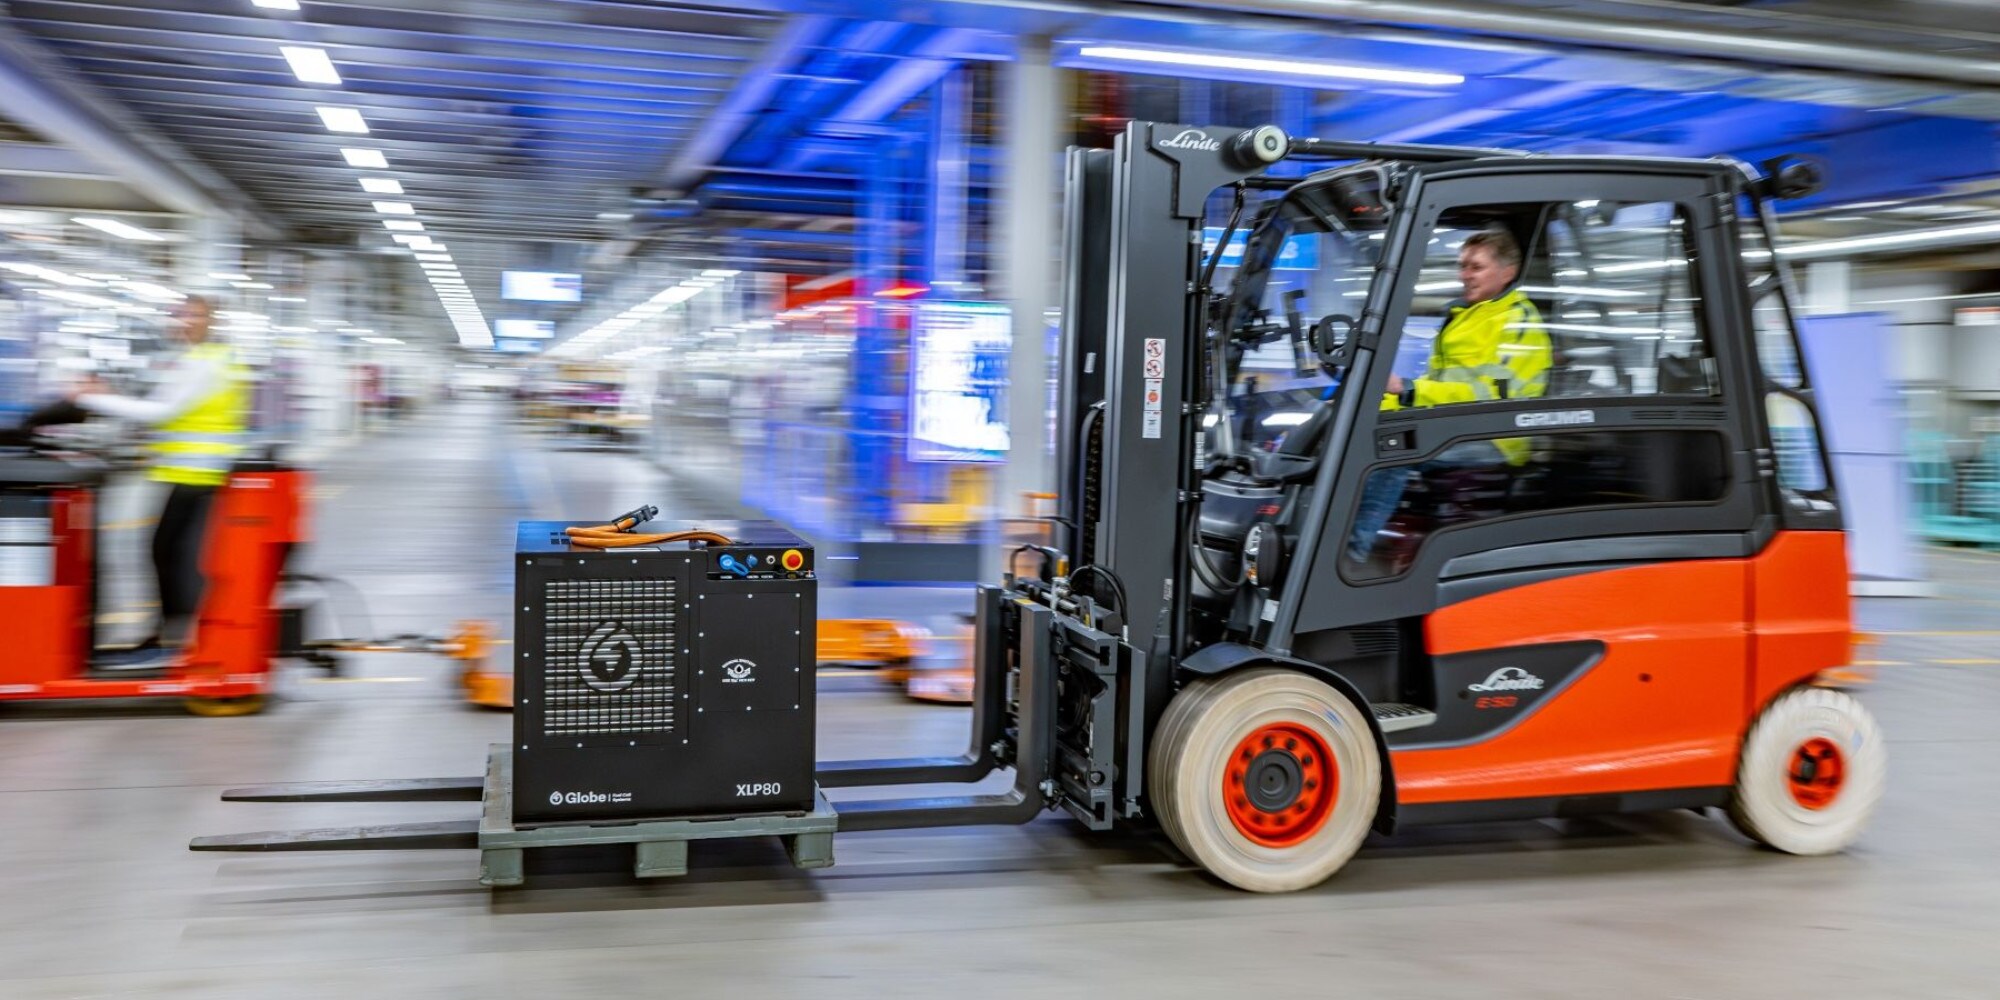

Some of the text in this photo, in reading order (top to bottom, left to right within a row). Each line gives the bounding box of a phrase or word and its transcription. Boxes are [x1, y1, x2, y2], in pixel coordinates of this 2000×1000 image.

[1159, 129, 1221, 151] Linde
[1467, 667, 1545, 691] Linde
[565, 791, 607, 804] Globe
[736, 782, 781, 797] XLP80
